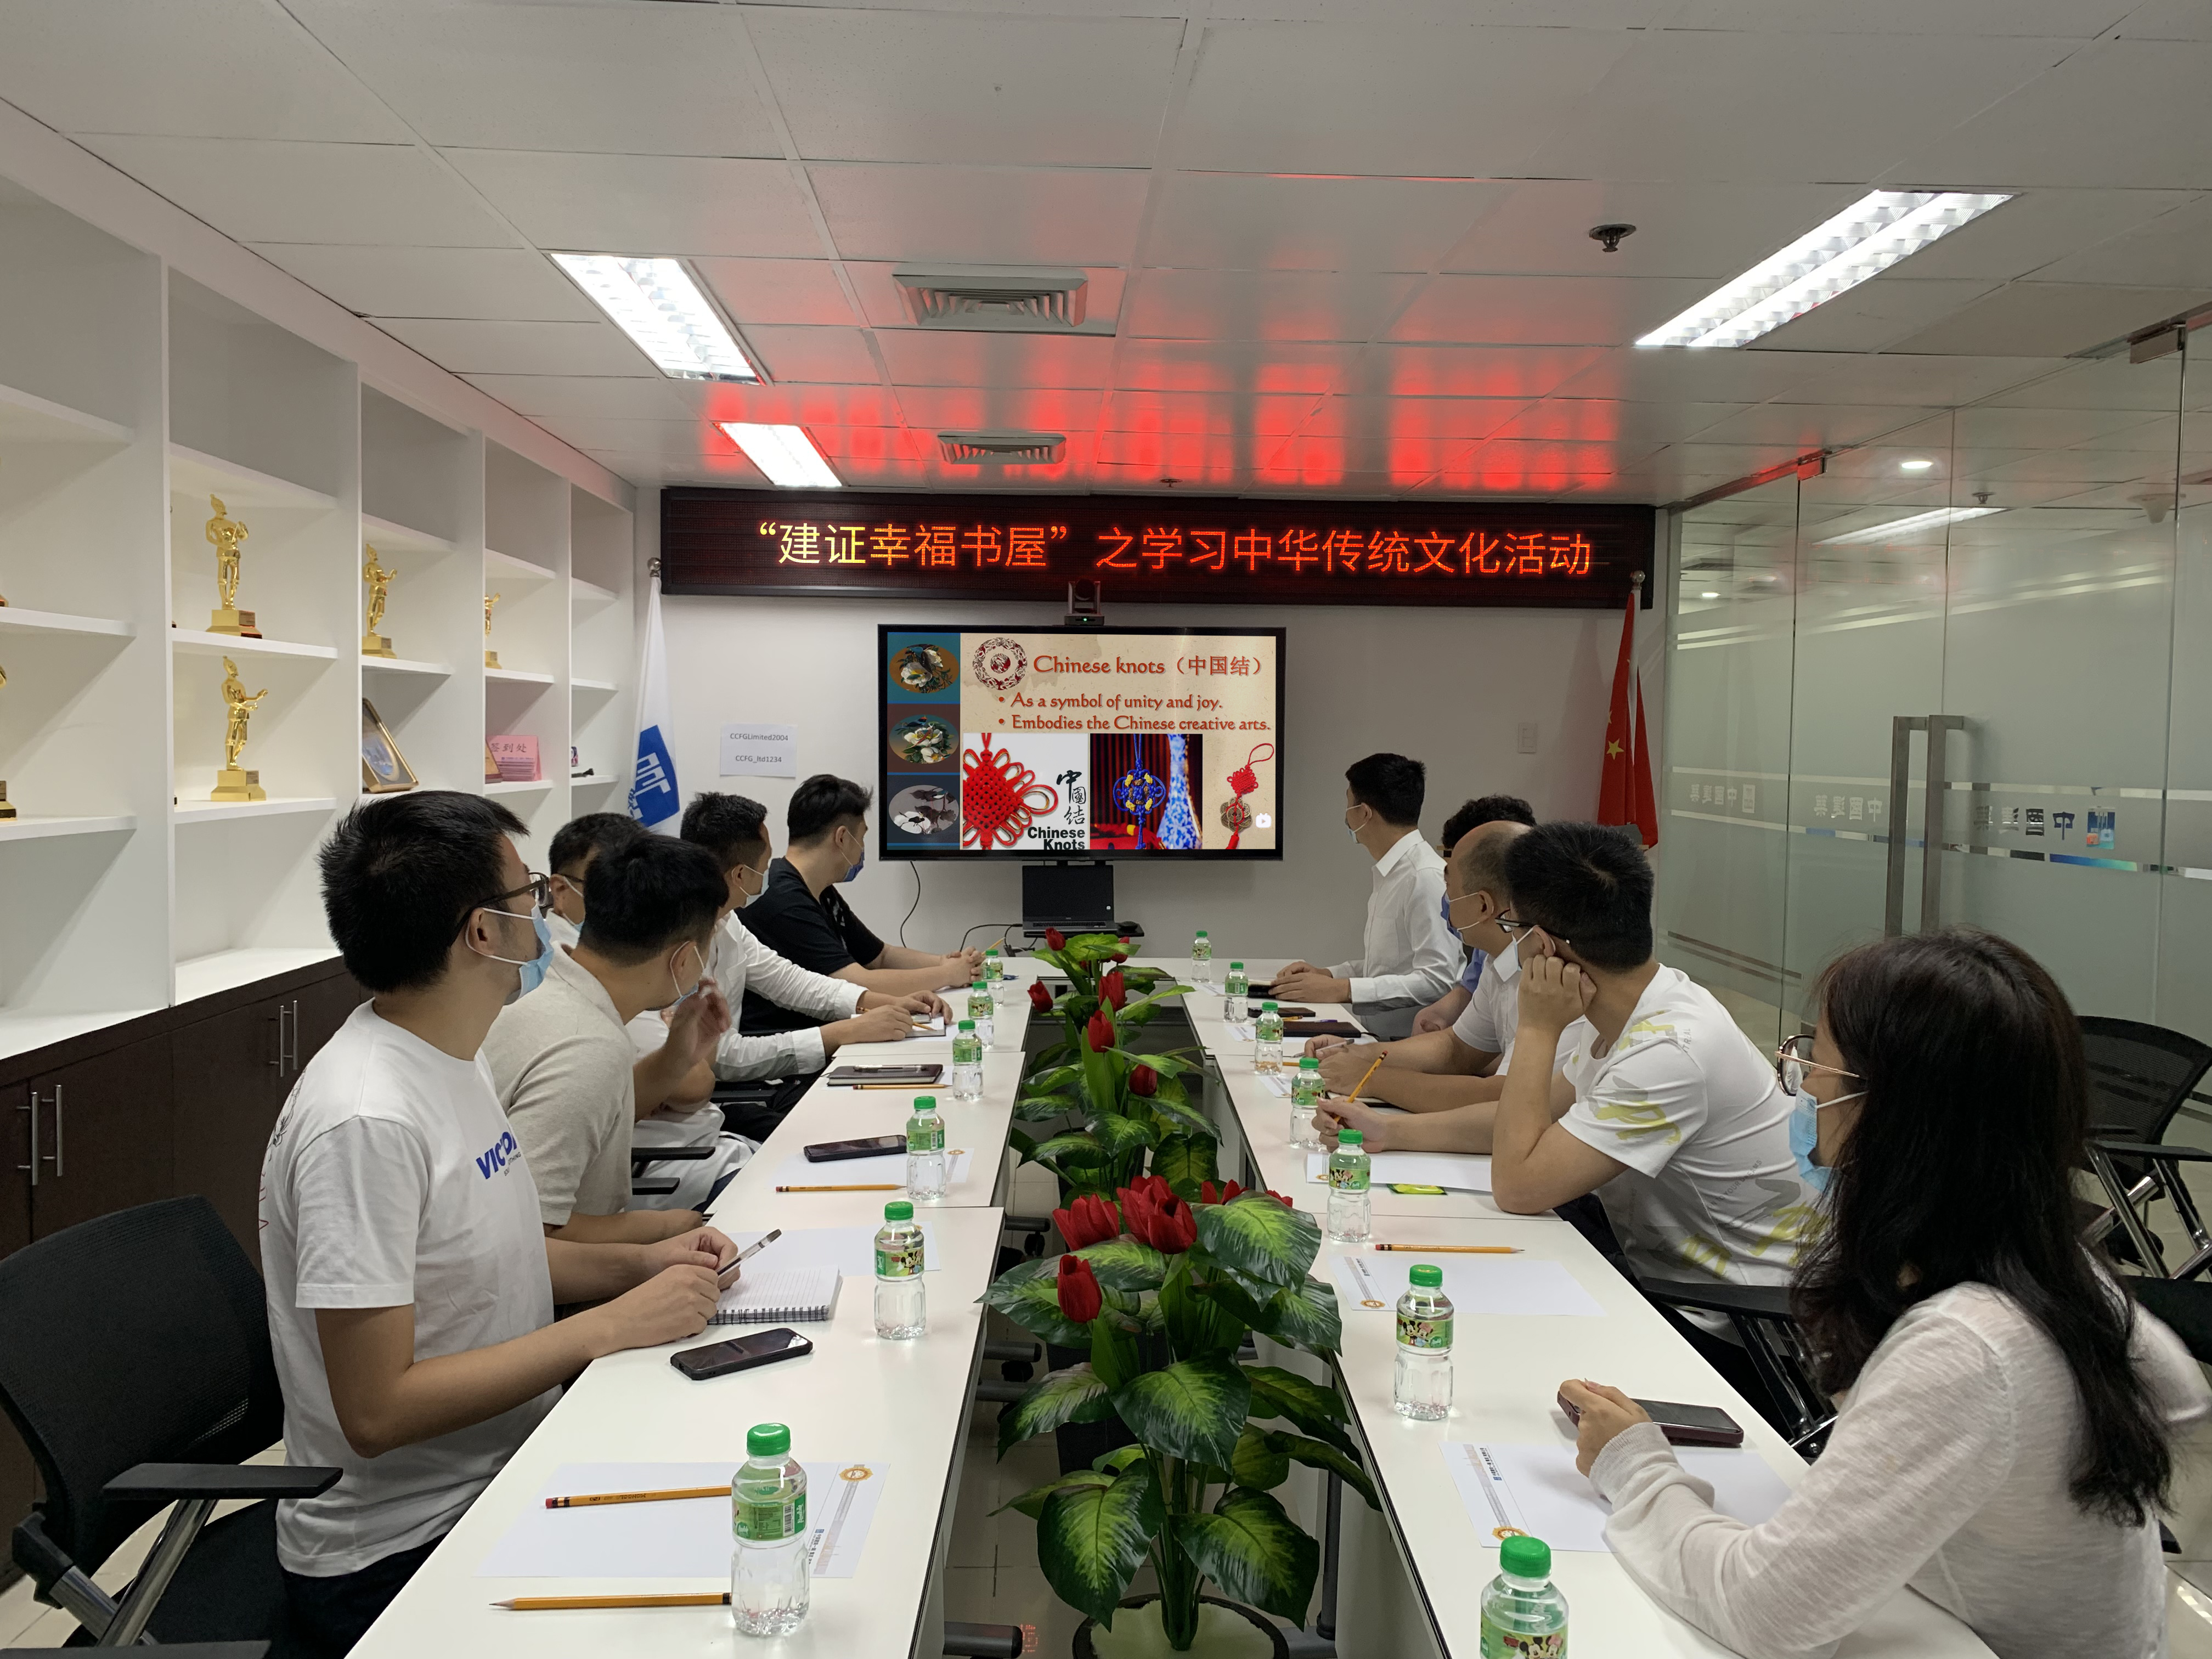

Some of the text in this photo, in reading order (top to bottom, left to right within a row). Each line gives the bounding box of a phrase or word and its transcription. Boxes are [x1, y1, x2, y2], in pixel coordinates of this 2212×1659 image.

[1034, 655, 1111, 674] Chinese
[1116, 656, 1166, 674] knots
[1011, 692, 1223, 712] As a symbol of unity and joy.
[1012, 714, 1272, 731] Embodies the Chinese creative arts.
[1028, 826, 1085, 839] Chinese
[1043, 839, 1085, 850] Knots
